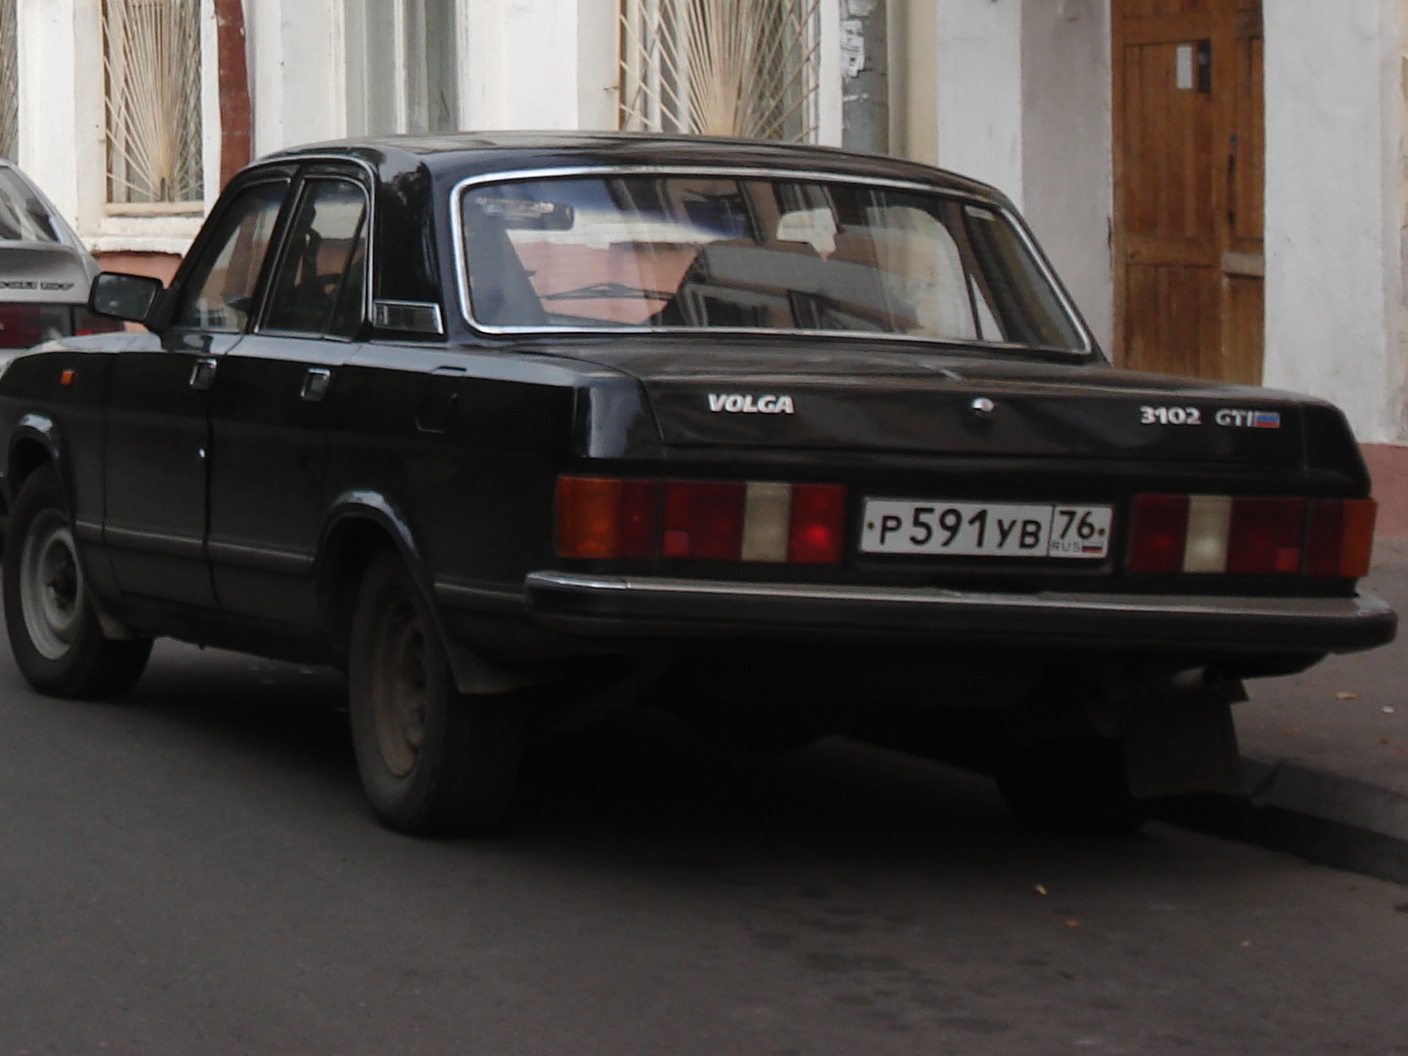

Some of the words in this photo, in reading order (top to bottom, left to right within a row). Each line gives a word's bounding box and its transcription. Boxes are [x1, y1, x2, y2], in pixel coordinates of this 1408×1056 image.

[708, 393, 794, 414] VOLGA
[1140, 405, 1201, 425] 3102
[1058, 510, 1096, 541] 76
